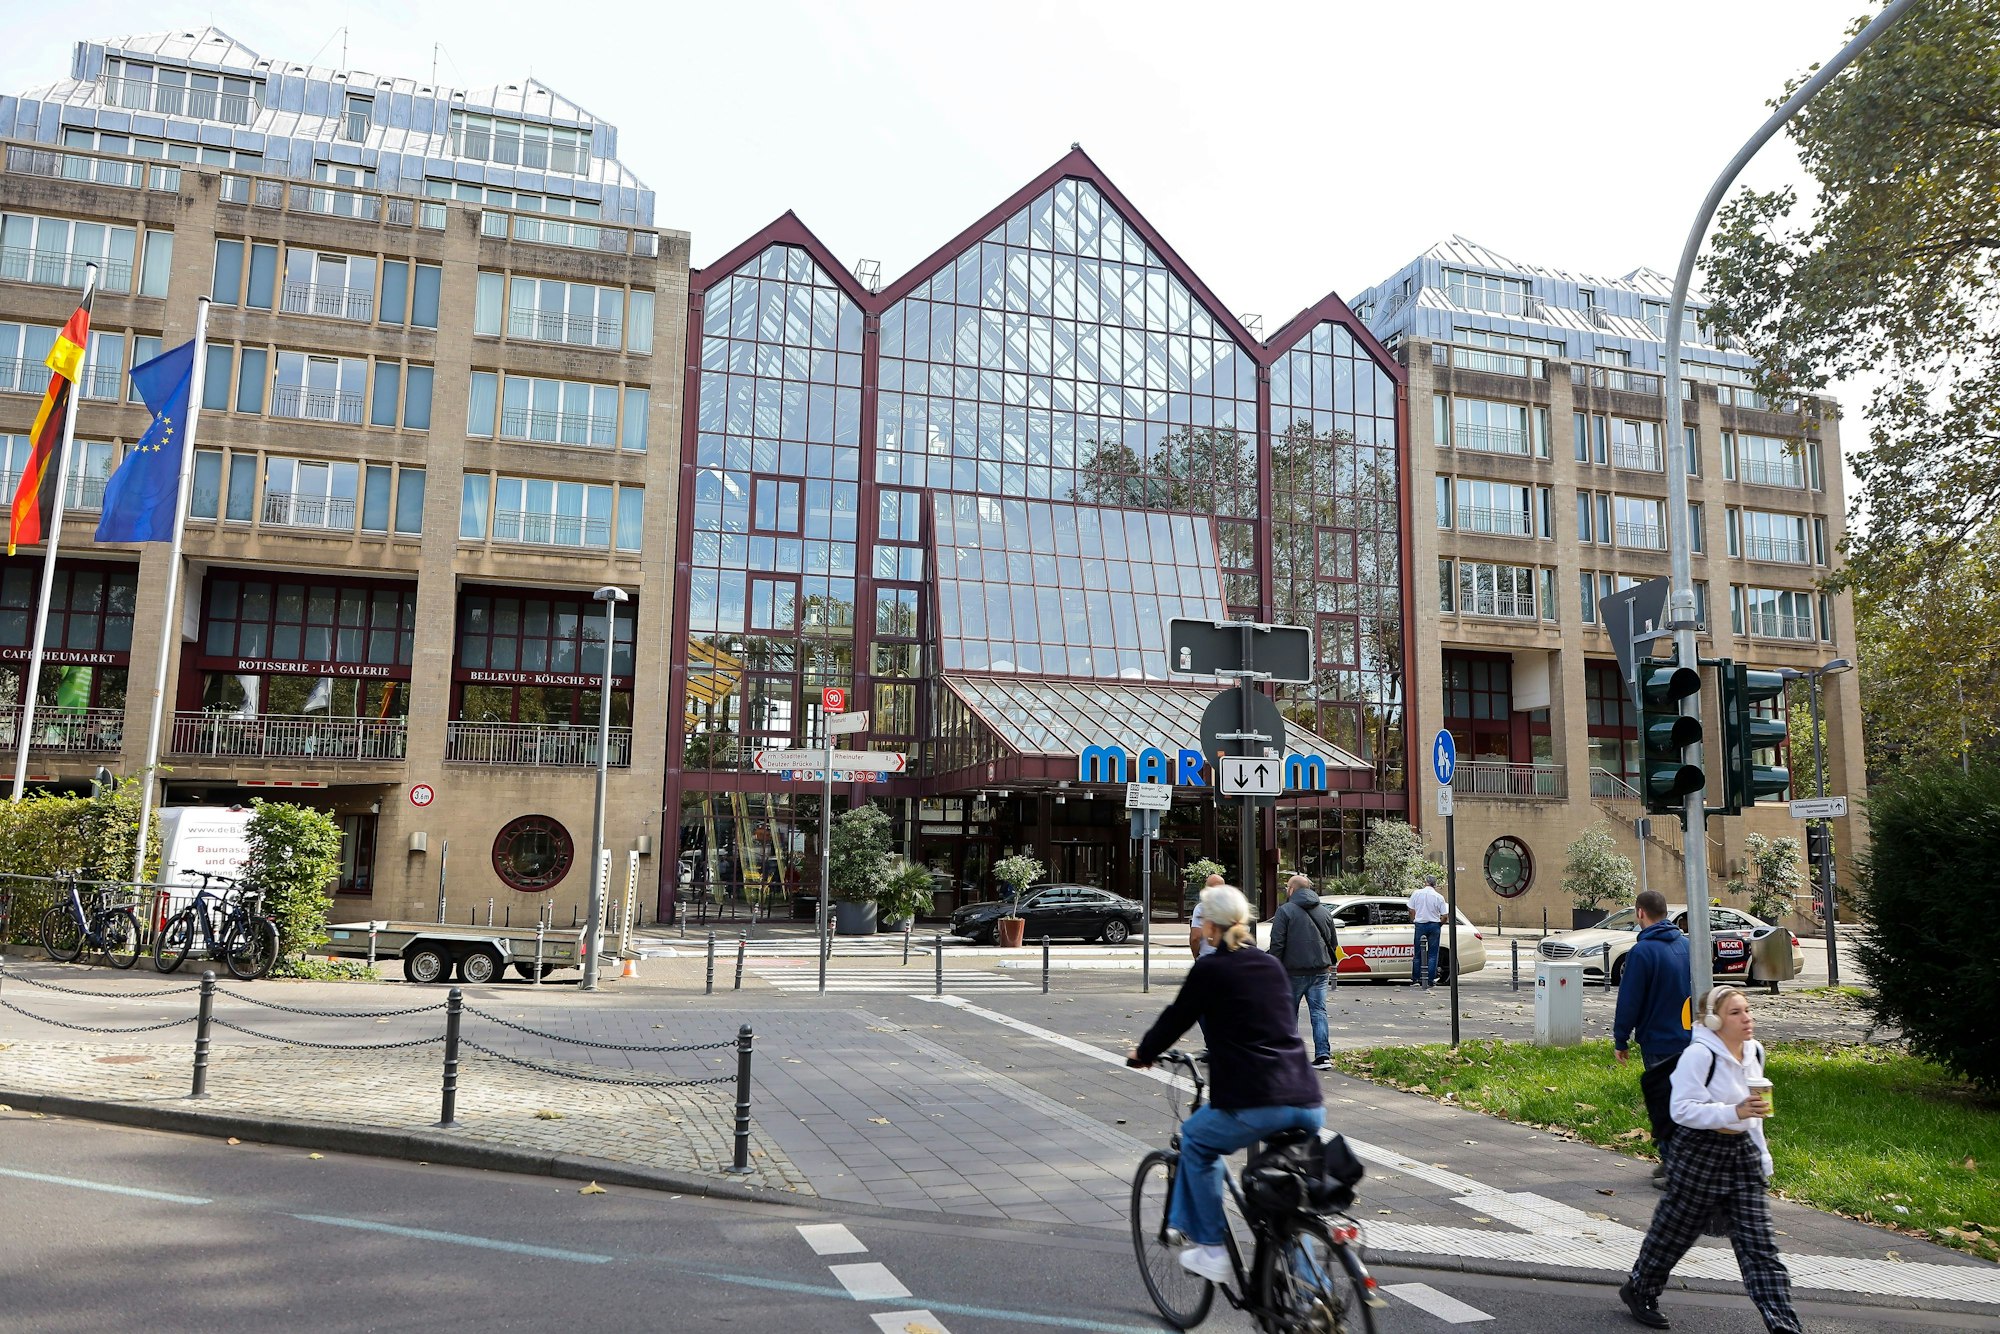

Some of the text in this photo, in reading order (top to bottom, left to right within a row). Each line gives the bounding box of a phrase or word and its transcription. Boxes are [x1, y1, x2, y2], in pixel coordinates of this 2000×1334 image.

[42, 651, 116, 663] HEUMARKT
[238, 660, 390, 676] ROTISSERIE LA GALERIE
[470, 671, 622, 687] BELLEVUE KÖLSCHE STFF
[829, 694, 838, 703] 90
[1363, 946, 1414, 957] SEGMÜLLER
